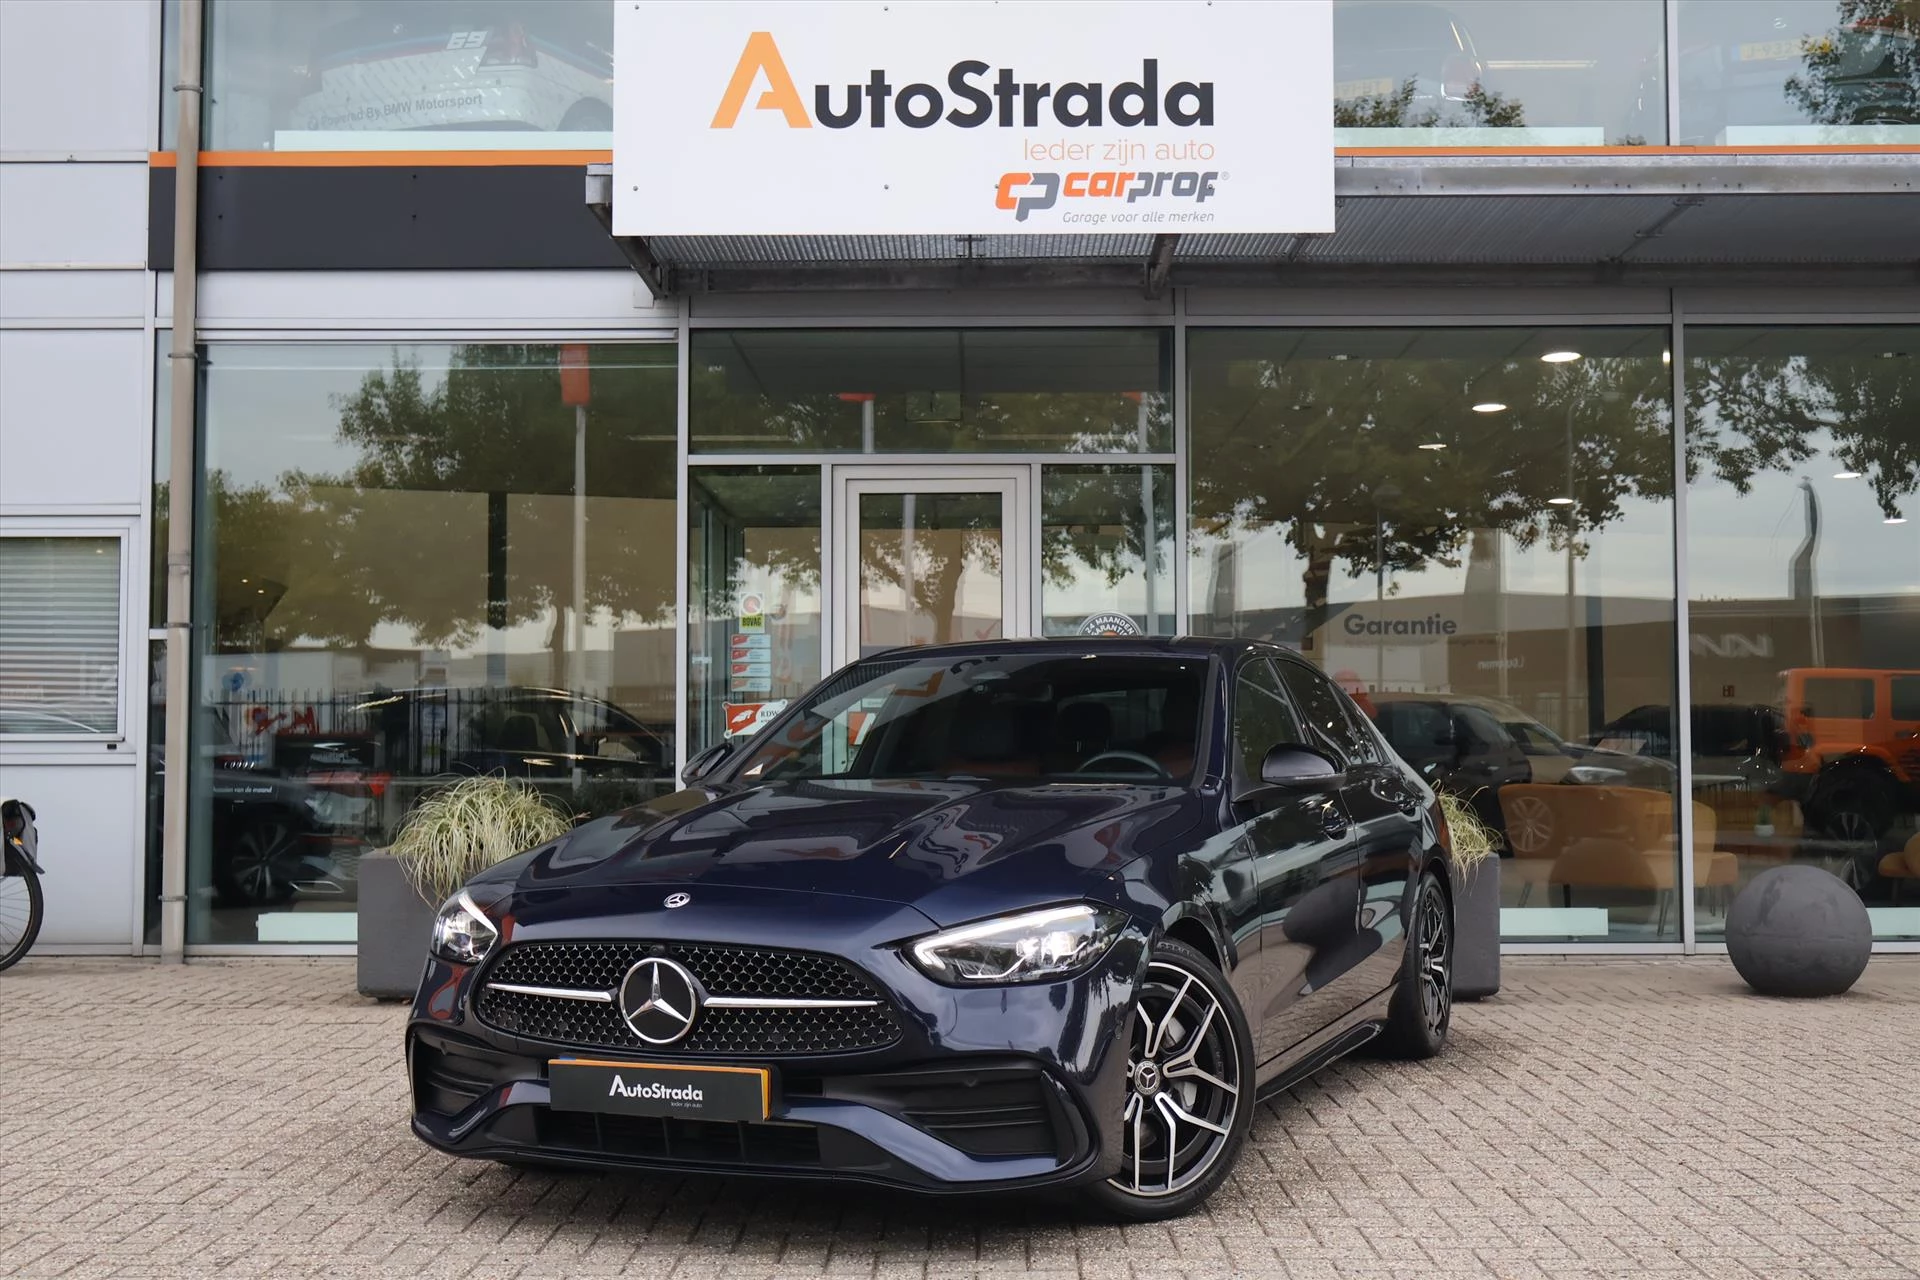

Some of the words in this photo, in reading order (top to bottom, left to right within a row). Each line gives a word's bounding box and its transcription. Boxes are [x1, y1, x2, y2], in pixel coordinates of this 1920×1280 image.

[447, 31, 488, 49] 69
[710, 31, 1215, 129] AutoStrada
[322, 109, 364, 126] Powered
[366, 106, 381, 121] By
[383, 101, 412, 117] BMW
[415, 94, 483, 111] Motorsport
[1024, 138, 1095, 161] Ieder
[1103, 138, 1145, 166] zijn
[1155, 139, 1215, 161] auto
[1062, 211, 1107, 226] Garage
[1109, 213, 1141, 223] voor
[1143, 211, 1167, 223] alle
[1169, 211, 1215, 223] merken
[742, 616, 762, 627] BOVAG
[1085, 623, 1096, 634] 24
[1095, 616, 1135, 635] MAANDEN
[1343, 612, 1457, 635] Garantie
[608, 1074, 703, 1101] AutoStrada
